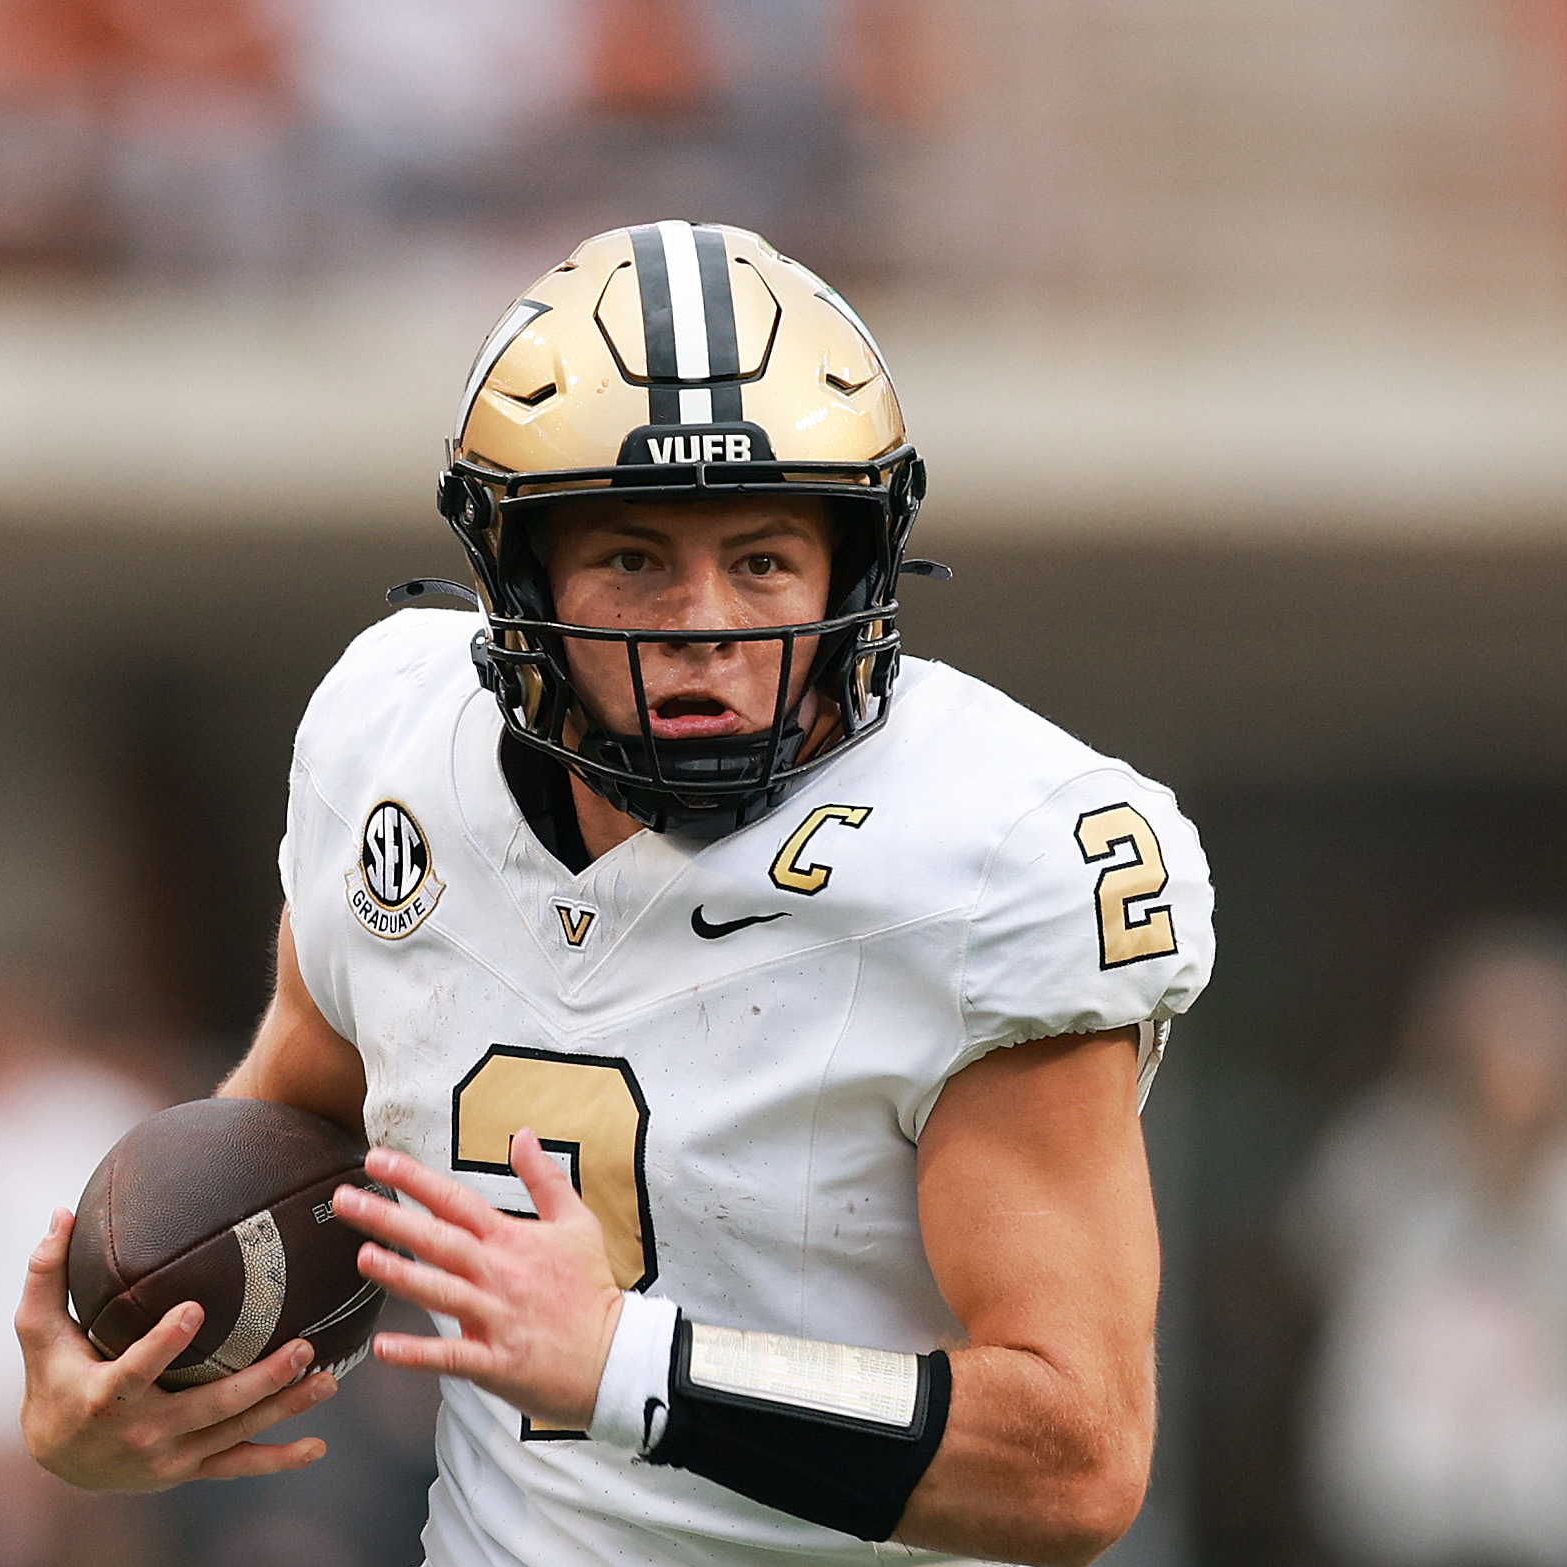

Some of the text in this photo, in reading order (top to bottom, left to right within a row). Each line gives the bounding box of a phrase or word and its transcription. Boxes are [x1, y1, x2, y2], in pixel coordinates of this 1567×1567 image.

[646, 434, 751, 464] VUFB
[365, 805, 421, 901] SEC
[768, 804, 873, 896] C
[352, 888, 426, 934] GRADUATE
[1073, 801, 1178, 970] 2
[554, 903, 597, 948] V
